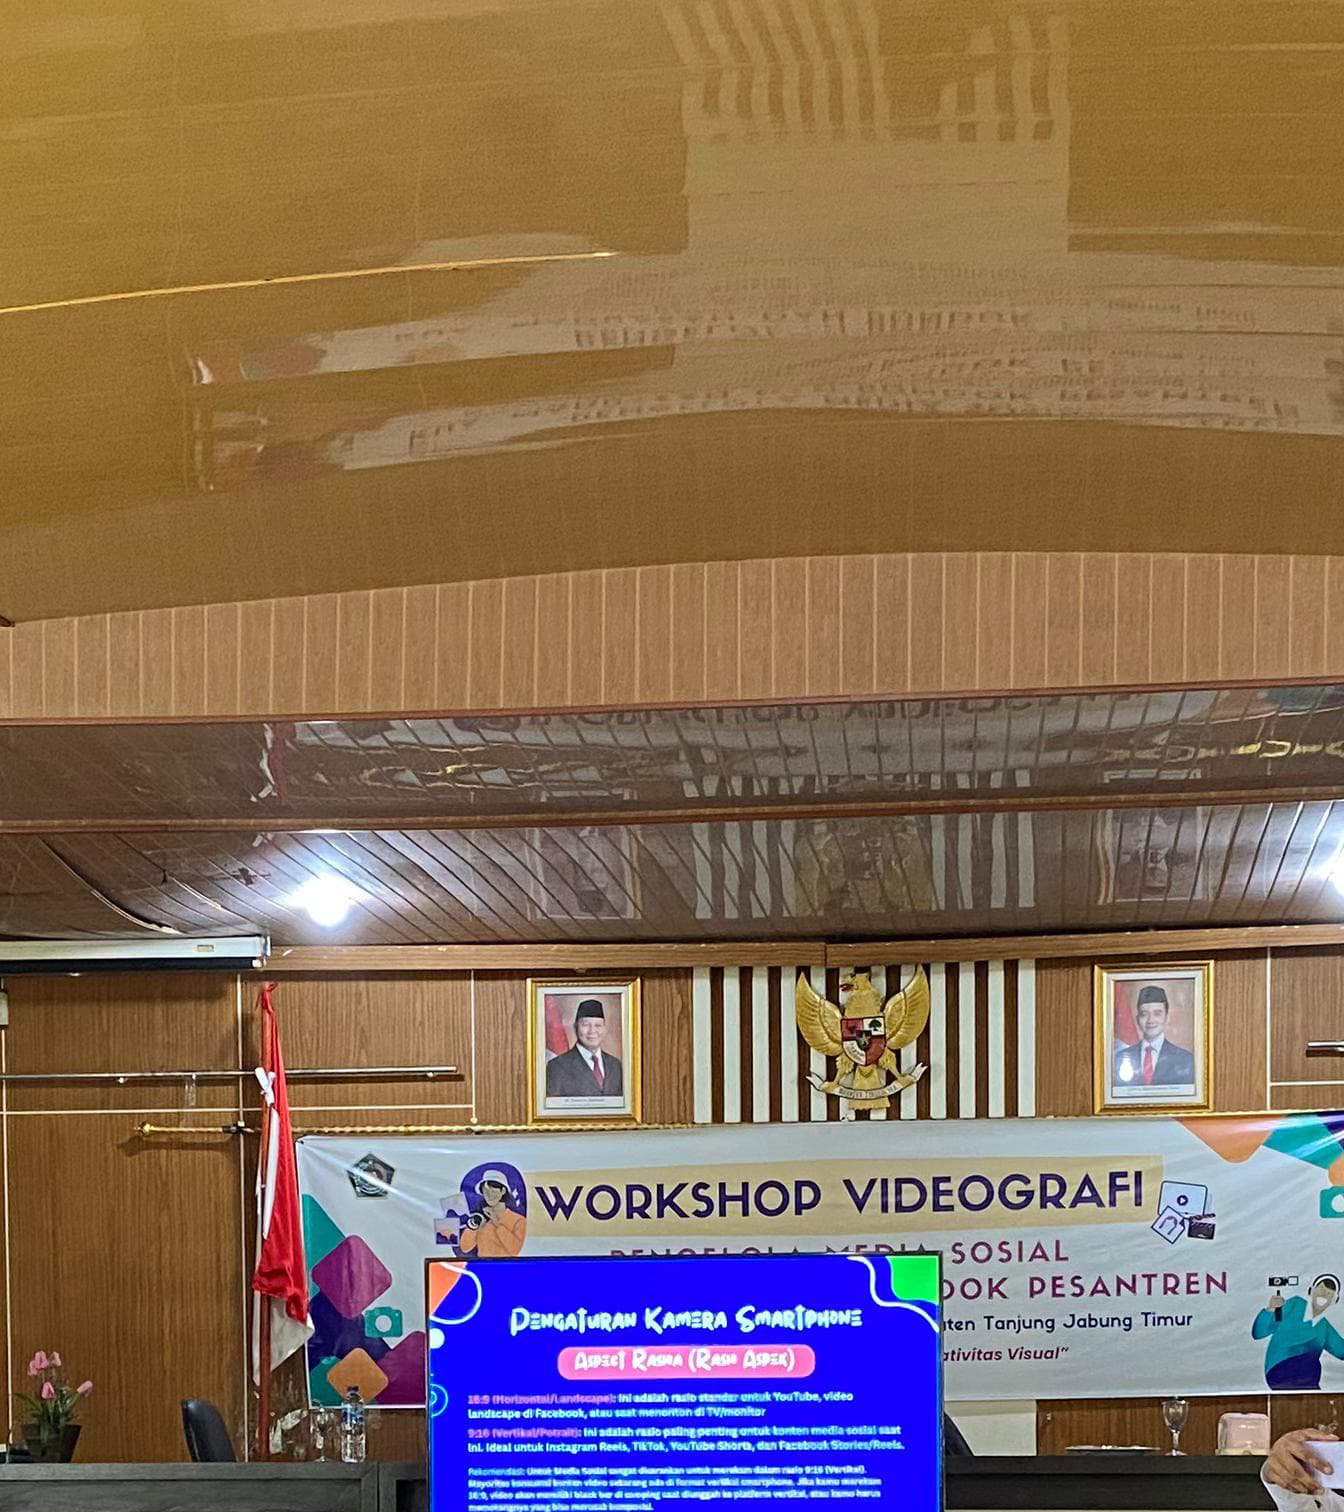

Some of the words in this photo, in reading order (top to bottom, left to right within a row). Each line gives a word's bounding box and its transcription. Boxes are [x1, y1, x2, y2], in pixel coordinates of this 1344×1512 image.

[534, 1180, 822, 1221] WORKSHOP
[842, 1170, 1143, 1214] VIDEOGRAFI
[951, 1239, 1069, 1264] SOSIAL
[1029, 1271, 1228, 1299] PESANTREN
[984, 1315, 1055, 1334] Tanjung
[1063, 1312, 1133, 1332] Jabung
[1140, 1311, 1193, 1328] Timur
